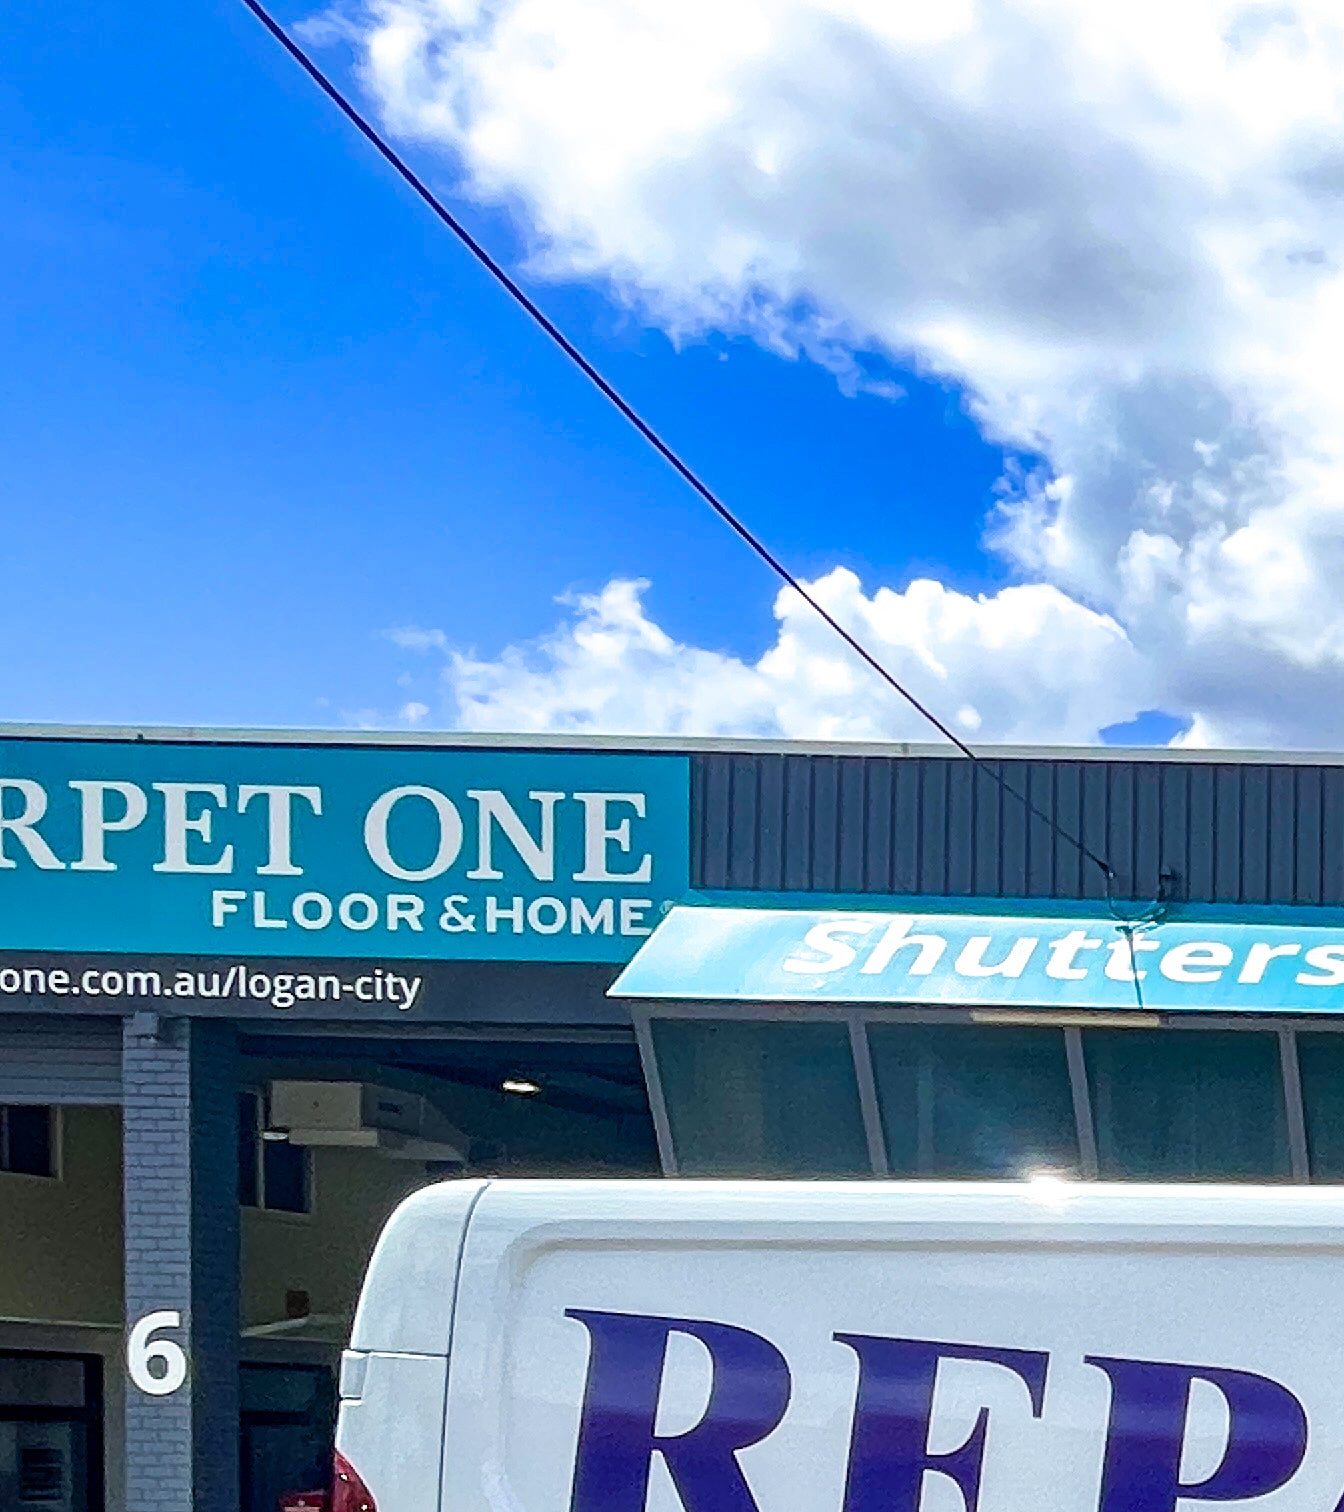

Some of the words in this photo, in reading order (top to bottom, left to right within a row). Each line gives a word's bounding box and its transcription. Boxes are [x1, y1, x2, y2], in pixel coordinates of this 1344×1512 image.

[364, 784, 654, 884] ONE
[211, 889, 423, 932] FLOOR
[439, 894, 478, 934] &
[486, 896, 653, 937] HOME
[0, 964, 421, 1010] one.com.au/logan-city
[126, 1309, 188, 1396] 6
